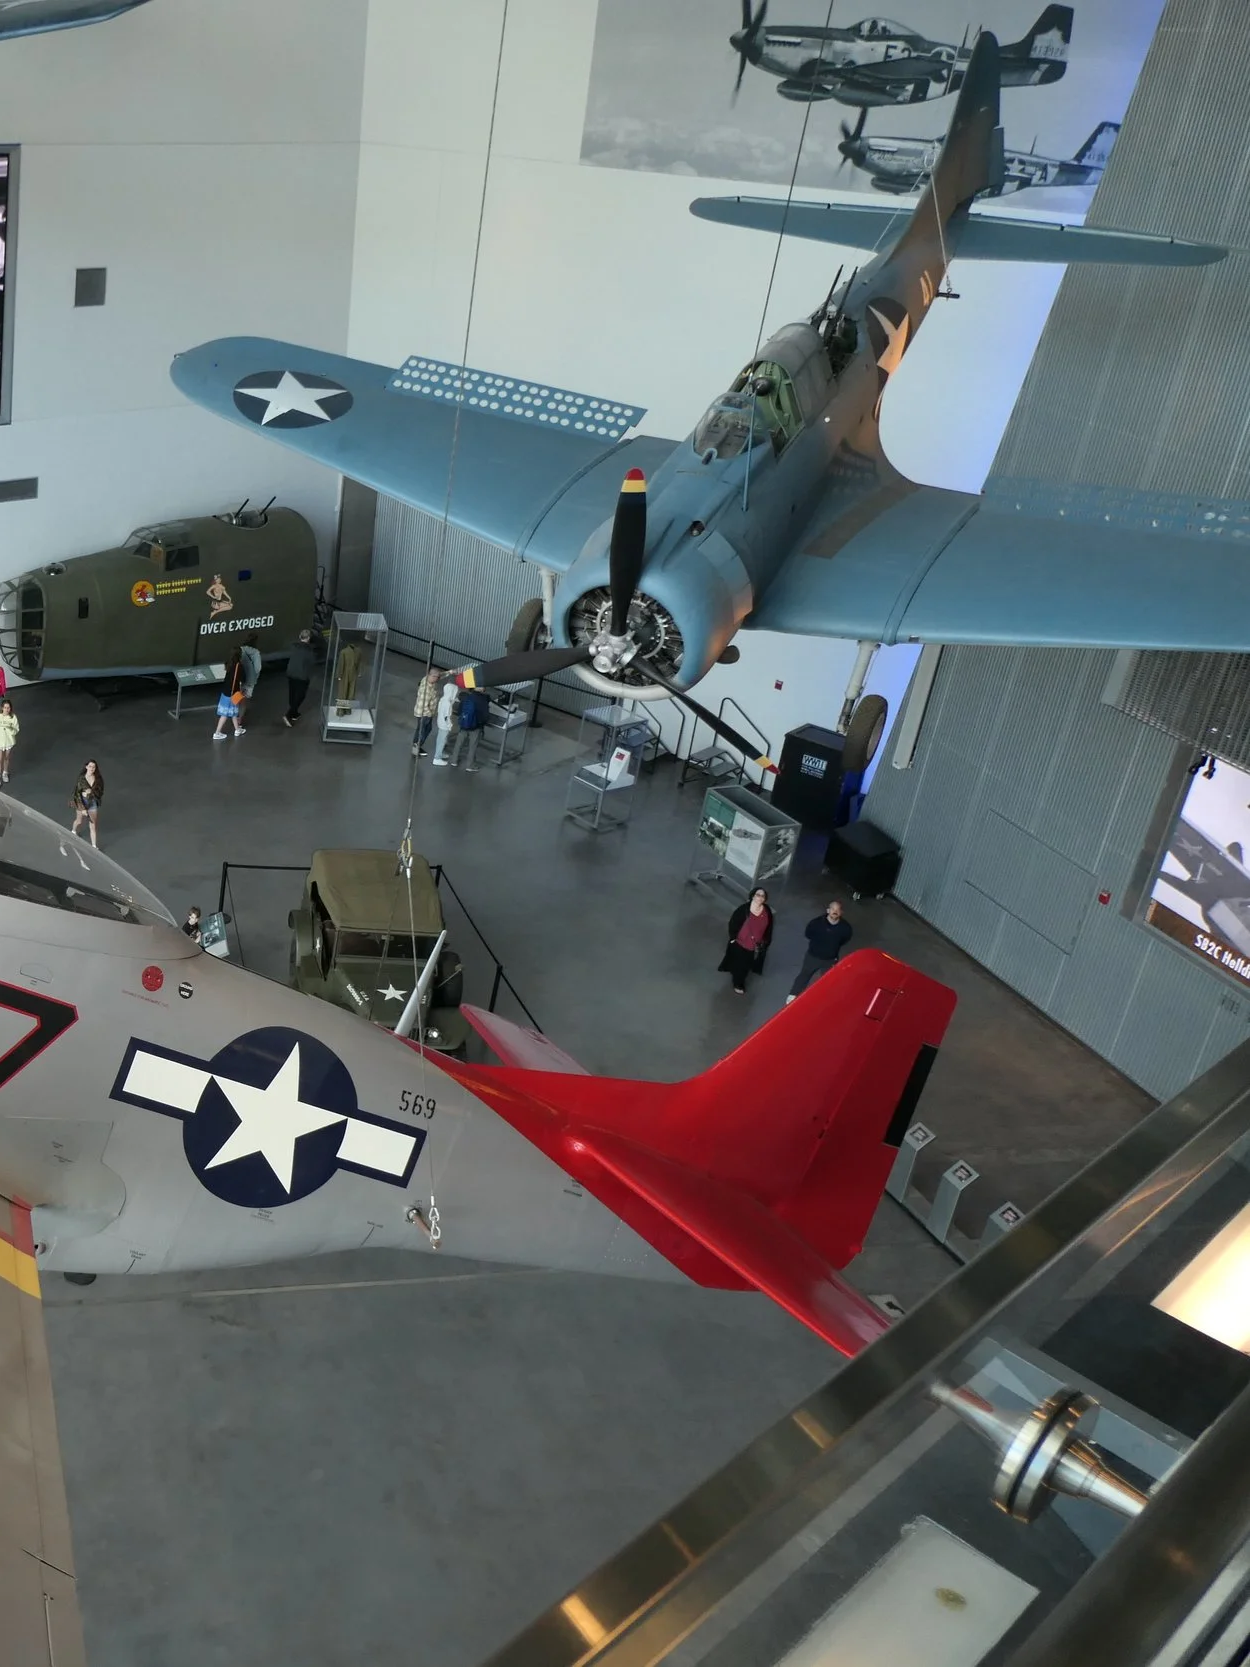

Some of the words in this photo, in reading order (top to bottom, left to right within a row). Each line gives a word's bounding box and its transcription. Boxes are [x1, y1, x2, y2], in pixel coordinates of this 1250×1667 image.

[200, 621, 227, 635] OVER
[228, 615, 275, 632] EXPOSED
[1194, 933, 1223, 960] SB2C
[399, 1089, 437, 1120] 569
